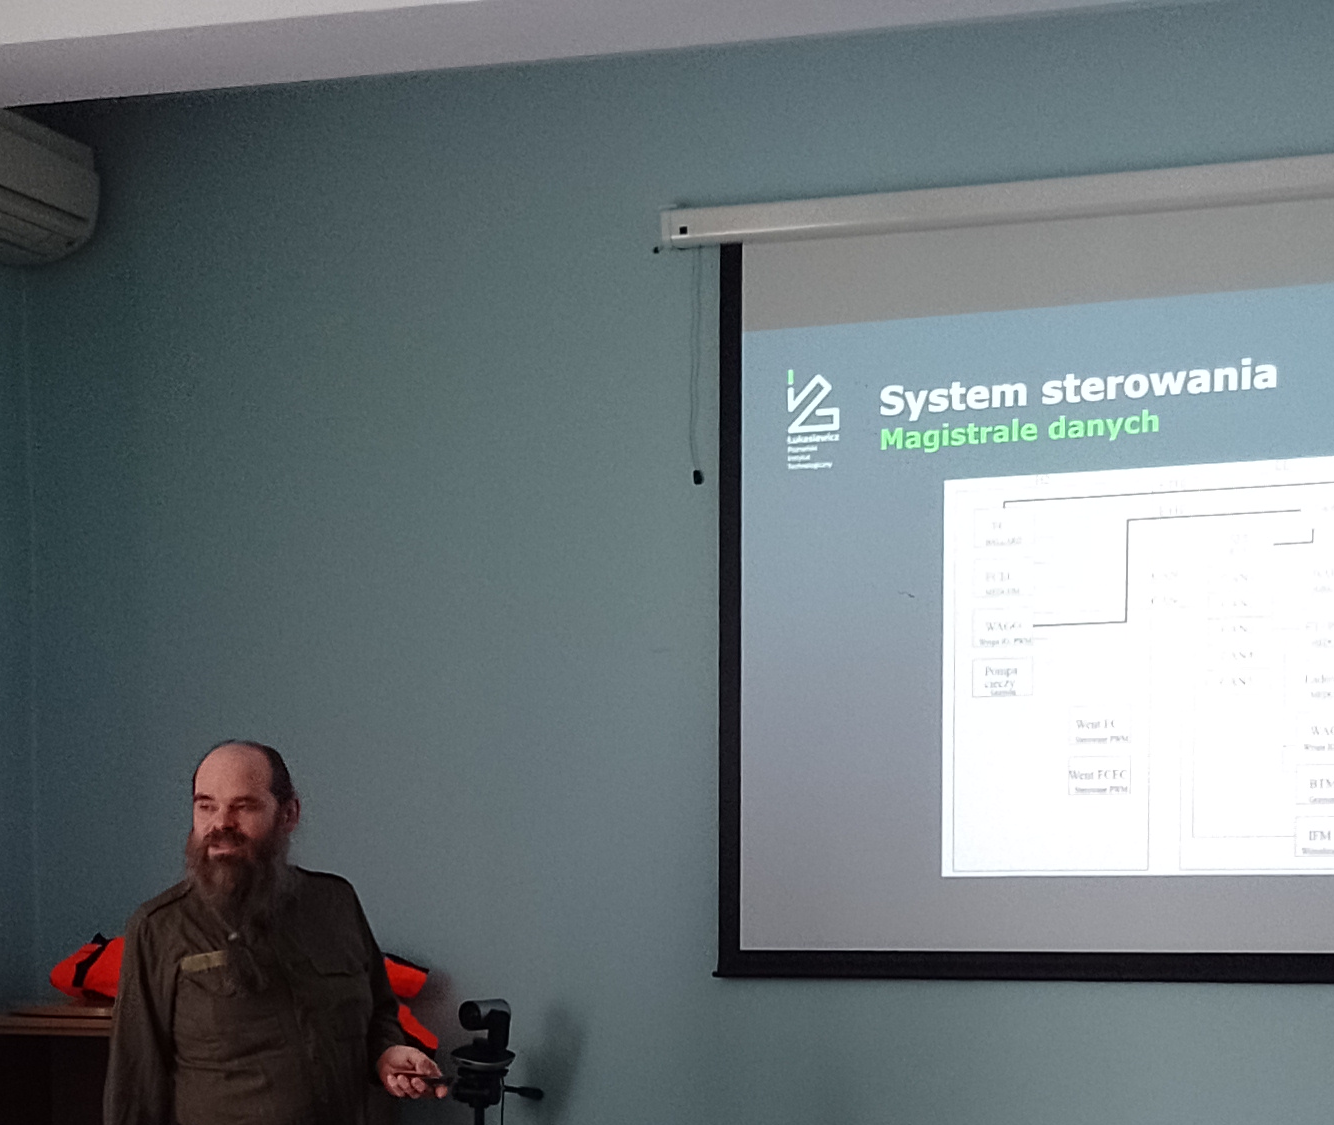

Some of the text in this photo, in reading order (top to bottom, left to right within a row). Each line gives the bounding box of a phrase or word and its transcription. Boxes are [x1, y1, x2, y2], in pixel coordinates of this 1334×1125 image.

[879, 357, 1278, 422] System sterowania
[880, 408, 1160, 453] Magistrale danych
[1308, 829, 1332, 842] IFM
